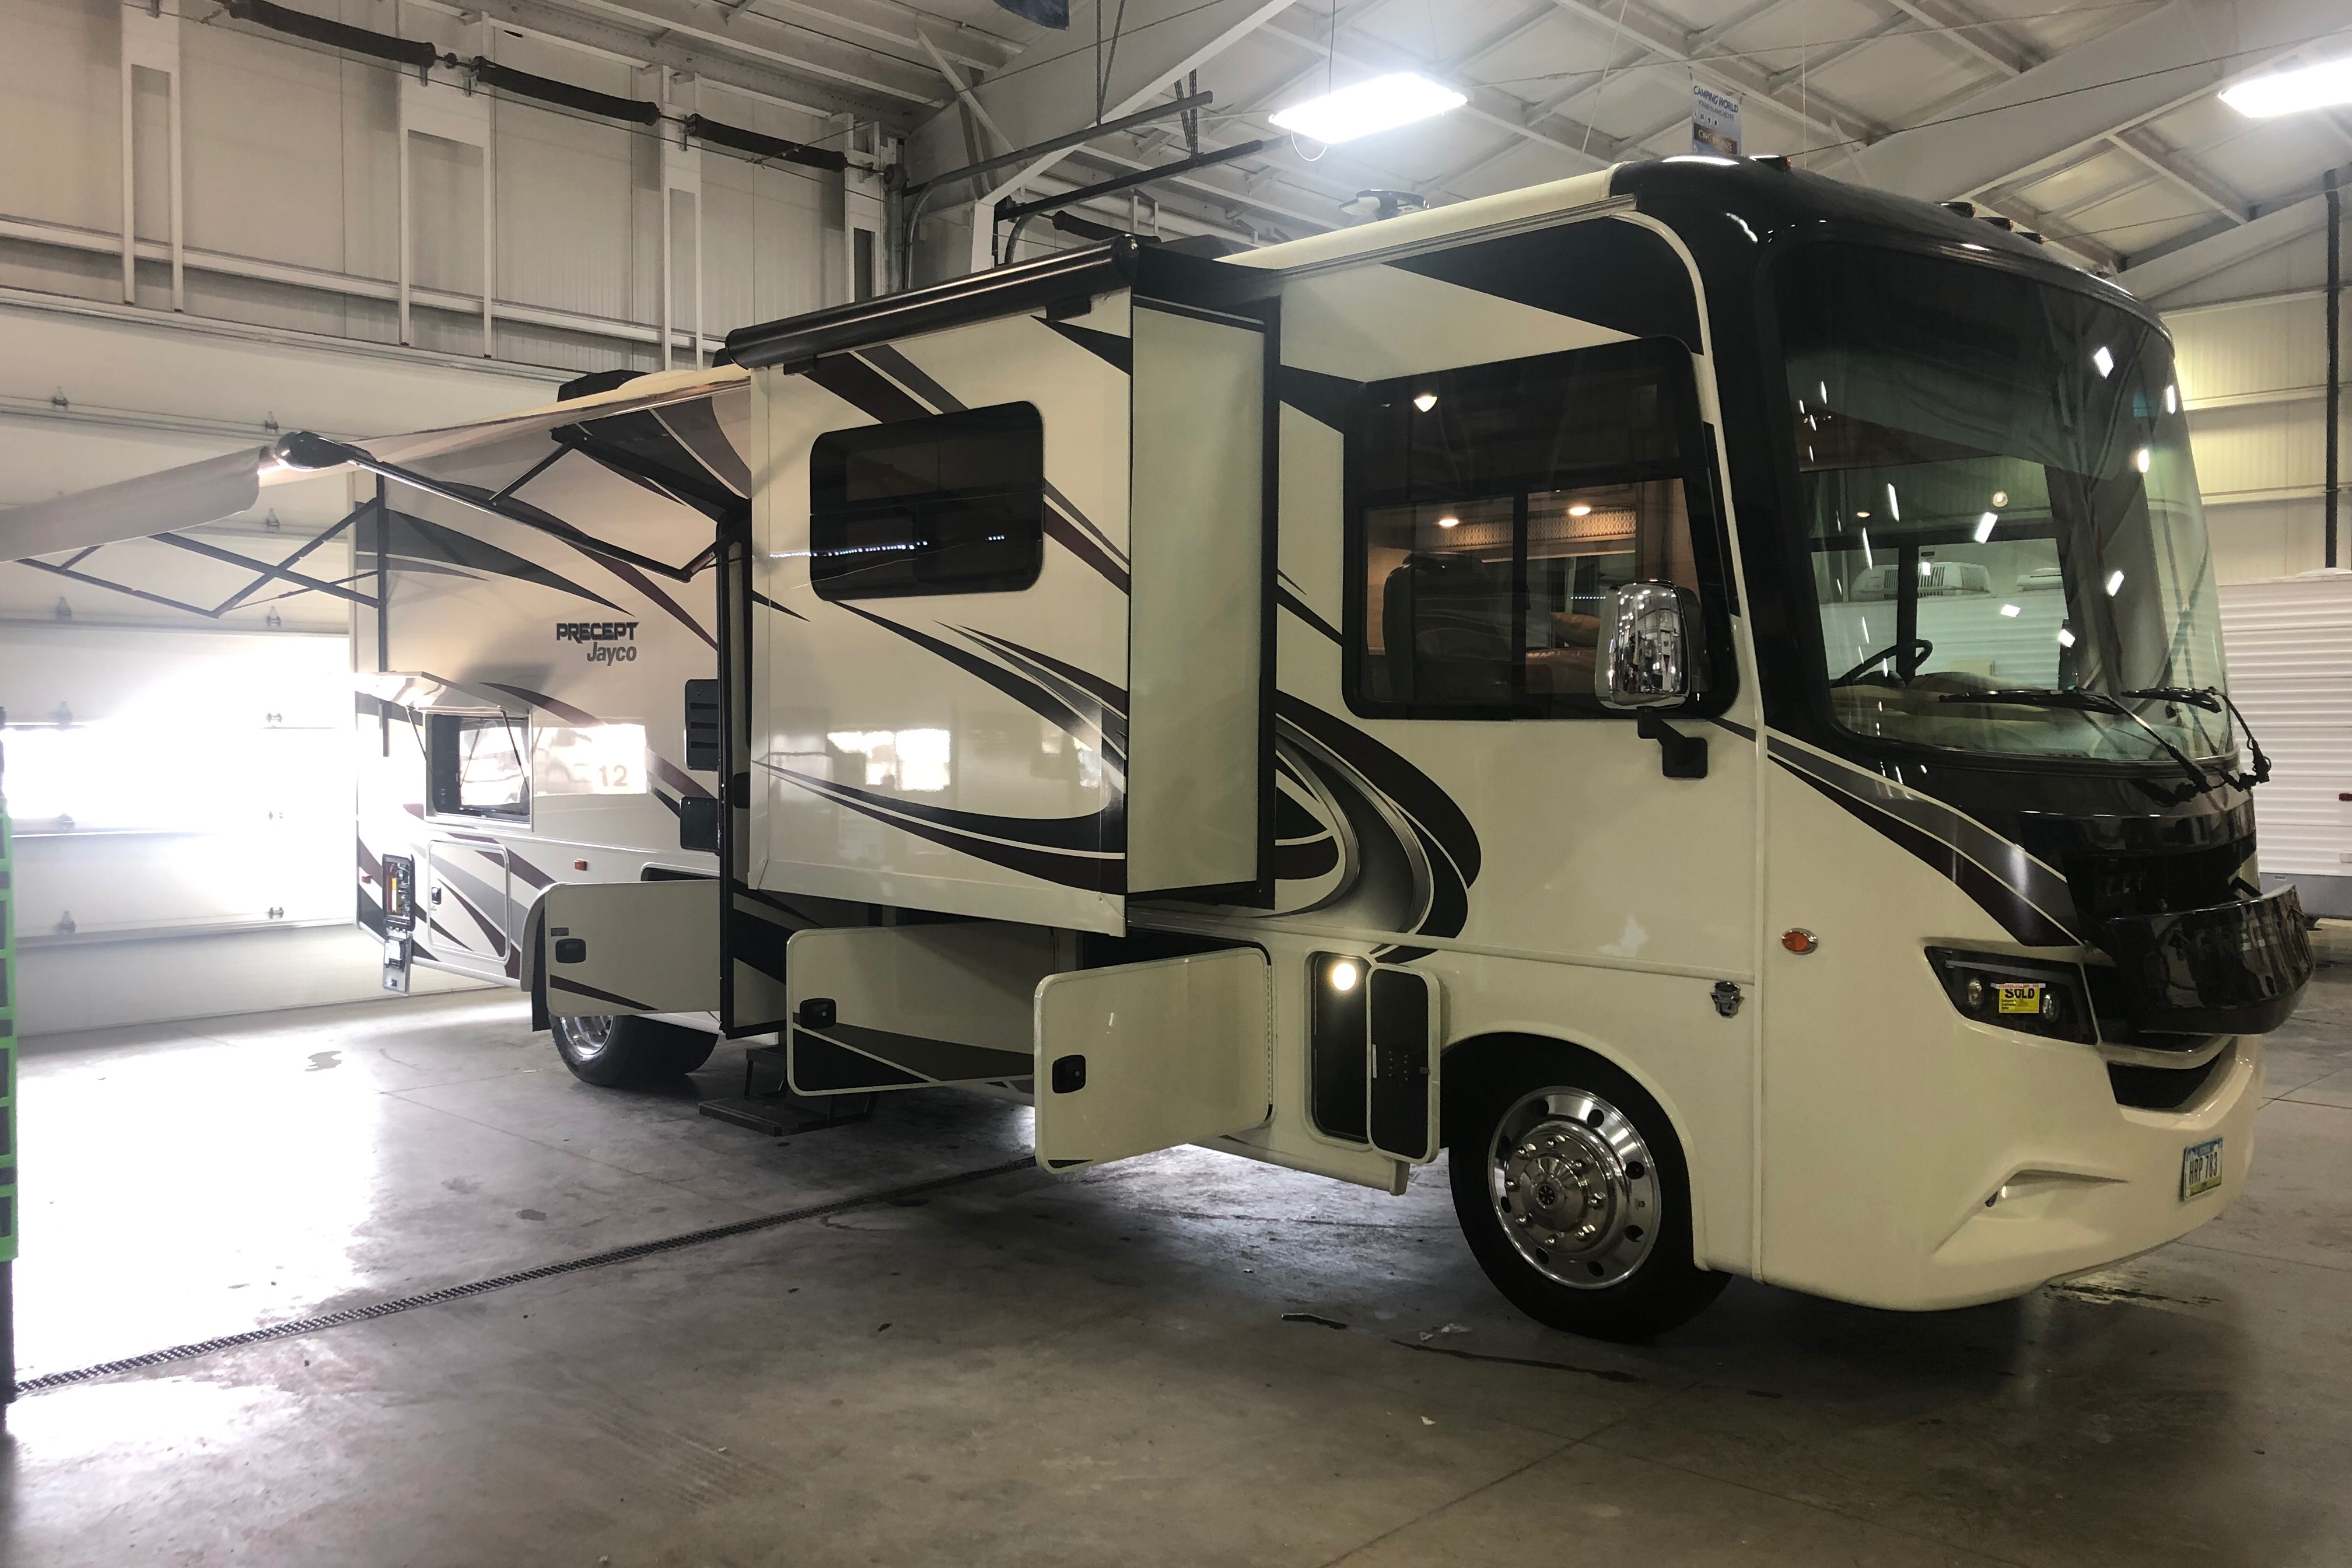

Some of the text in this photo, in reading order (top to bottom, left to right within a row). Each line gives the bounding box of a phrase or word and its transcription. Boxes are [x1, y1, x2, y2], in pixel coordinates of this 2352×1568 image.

[1693, 85, 1739, 113] CAMPING WORLD
[556, 621, 640, 644] PRECEPT
[587, 641, 637, 667] Jayco
[598, 764, 628, 787] 12
[2004, 988, 2035, 999] SOLD
[2189, 1157, 2203, 1186] HRP
